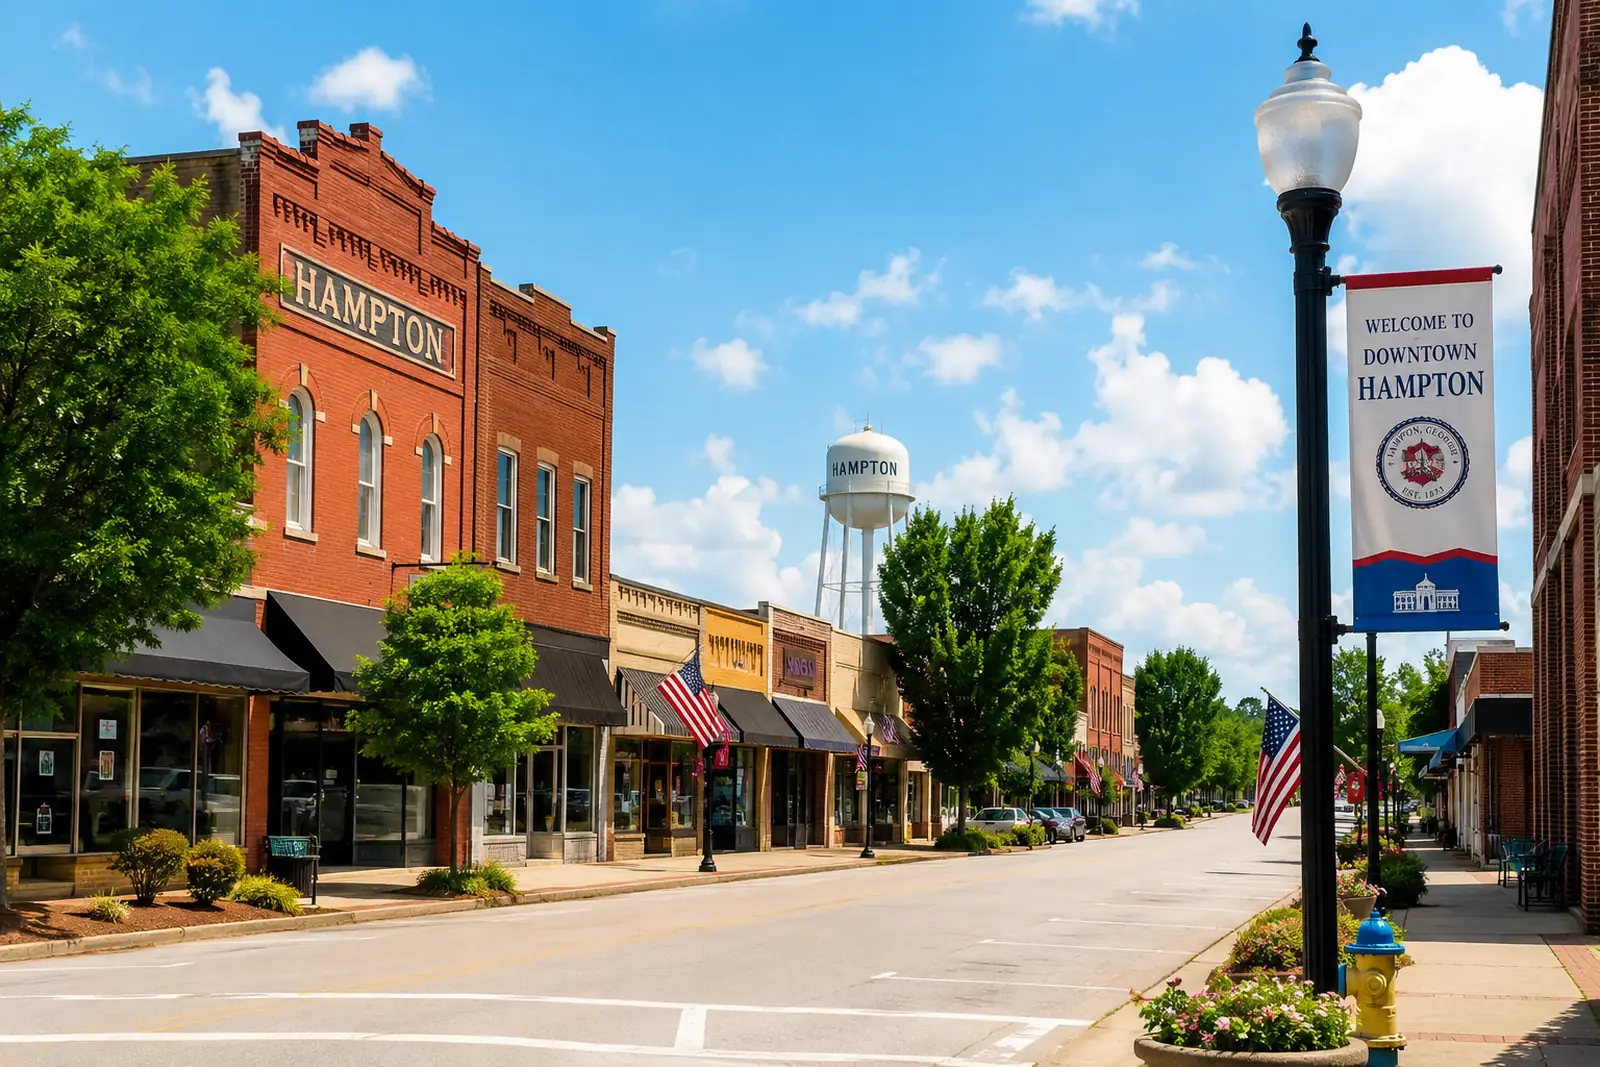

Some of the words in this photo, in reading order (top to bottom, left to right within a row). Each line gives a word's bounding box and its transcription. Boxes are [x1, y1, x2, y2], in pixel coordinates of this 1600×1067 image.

[295, 261, 443, 364] HAMPTON
[1365, 314, 1447, 334] WELCOME
[1452, 313, 1474, 329] TO
[1363, 343, 1477, 366] DOWNTOWN
[1358, 371, 1484, 401] HAMPTON
[832, 460, 897, 477] HAMPTON
